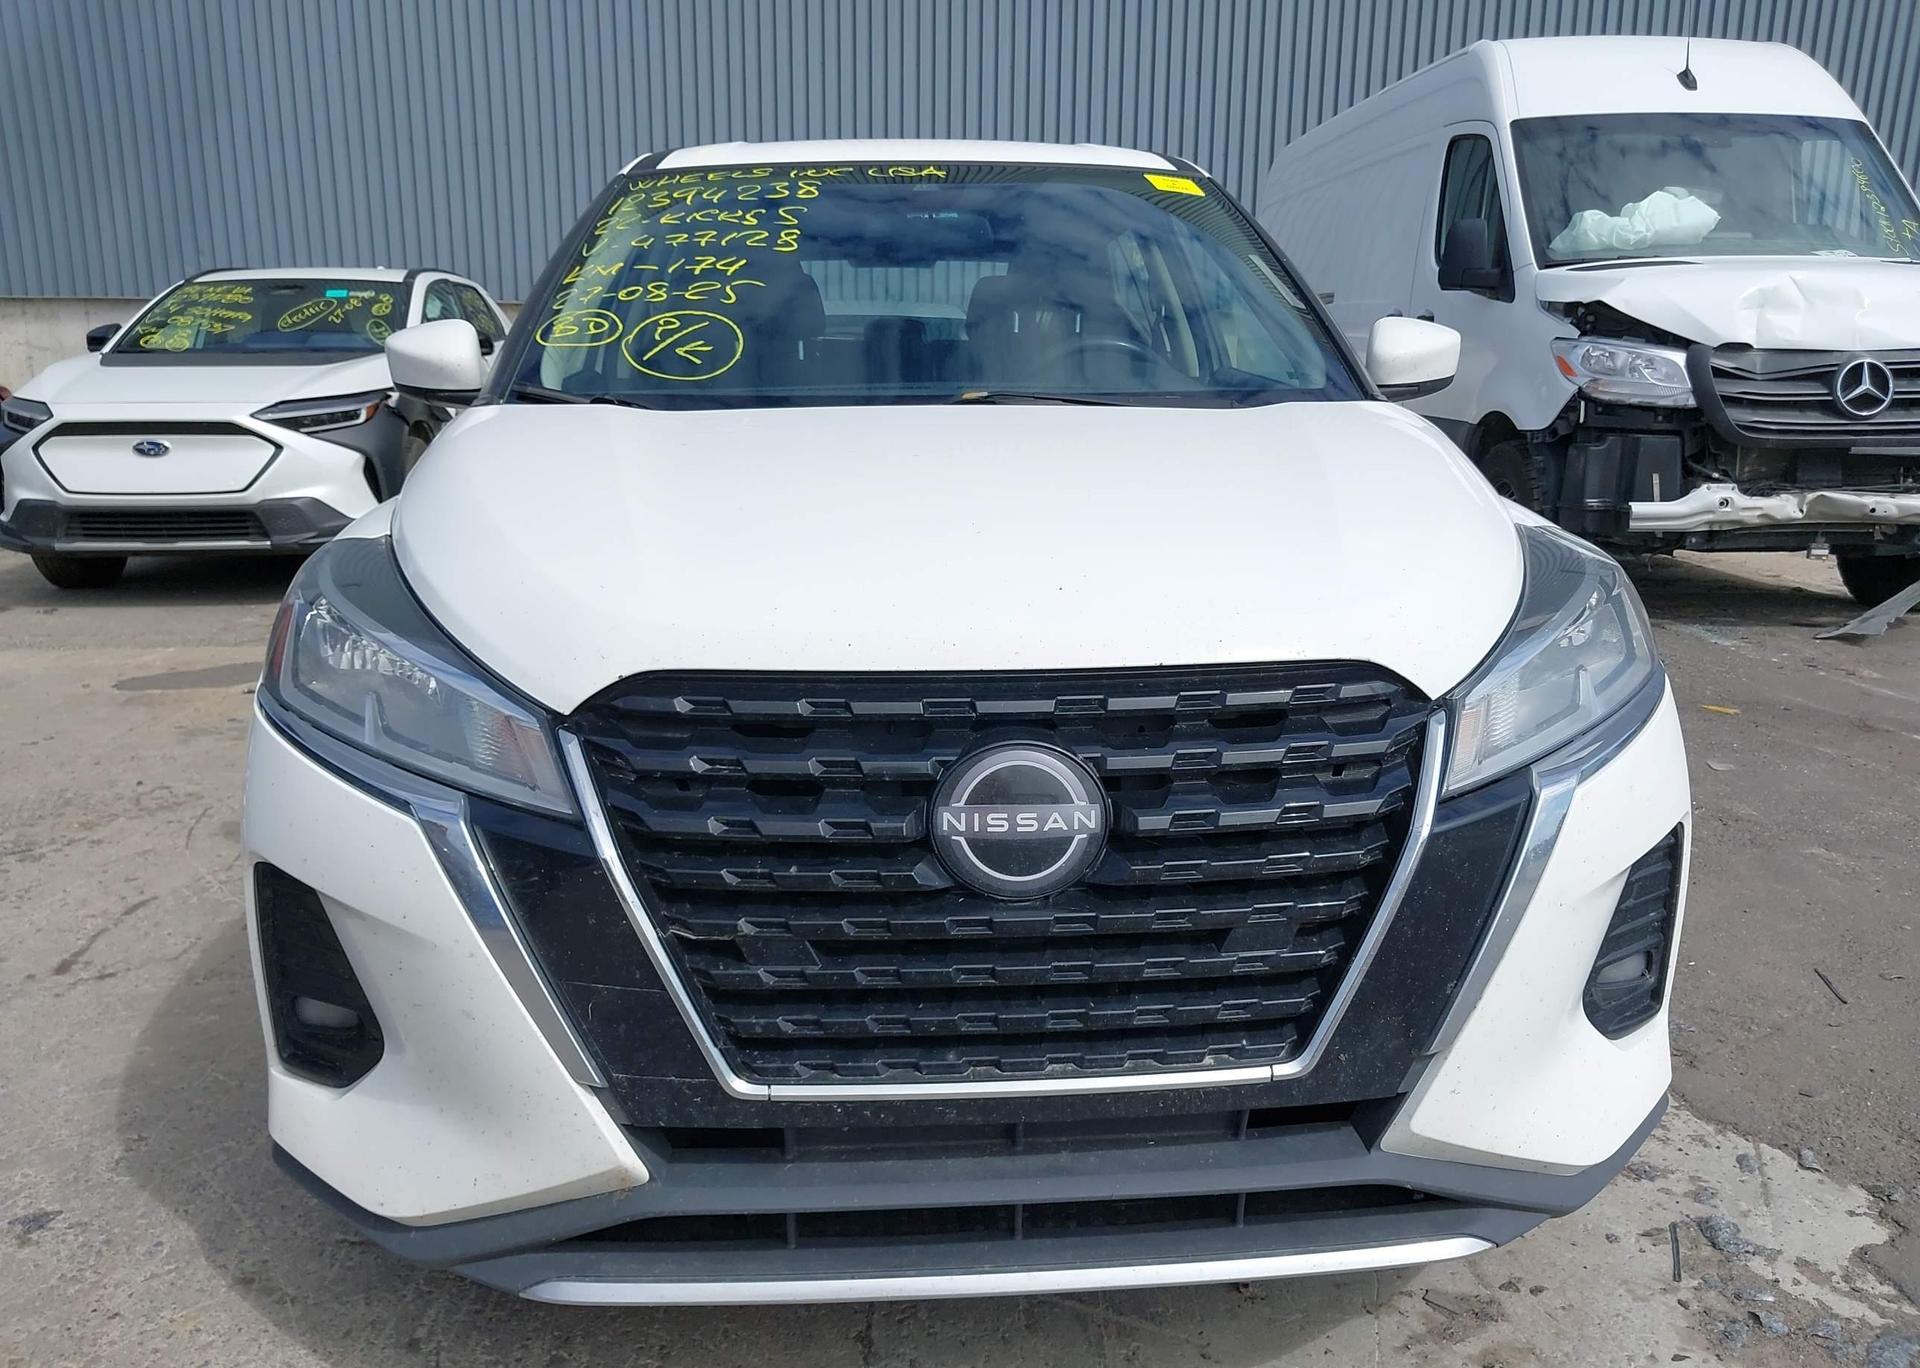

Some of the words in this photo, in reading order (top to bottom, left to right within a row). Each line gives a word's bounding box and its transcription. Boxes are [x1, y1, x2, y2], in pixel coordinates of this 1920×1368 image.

[628, 167, 774, 191] WHEELS
[868, 166, 947, 179] USA
[942, 810, 1096, 833] NISSAN
